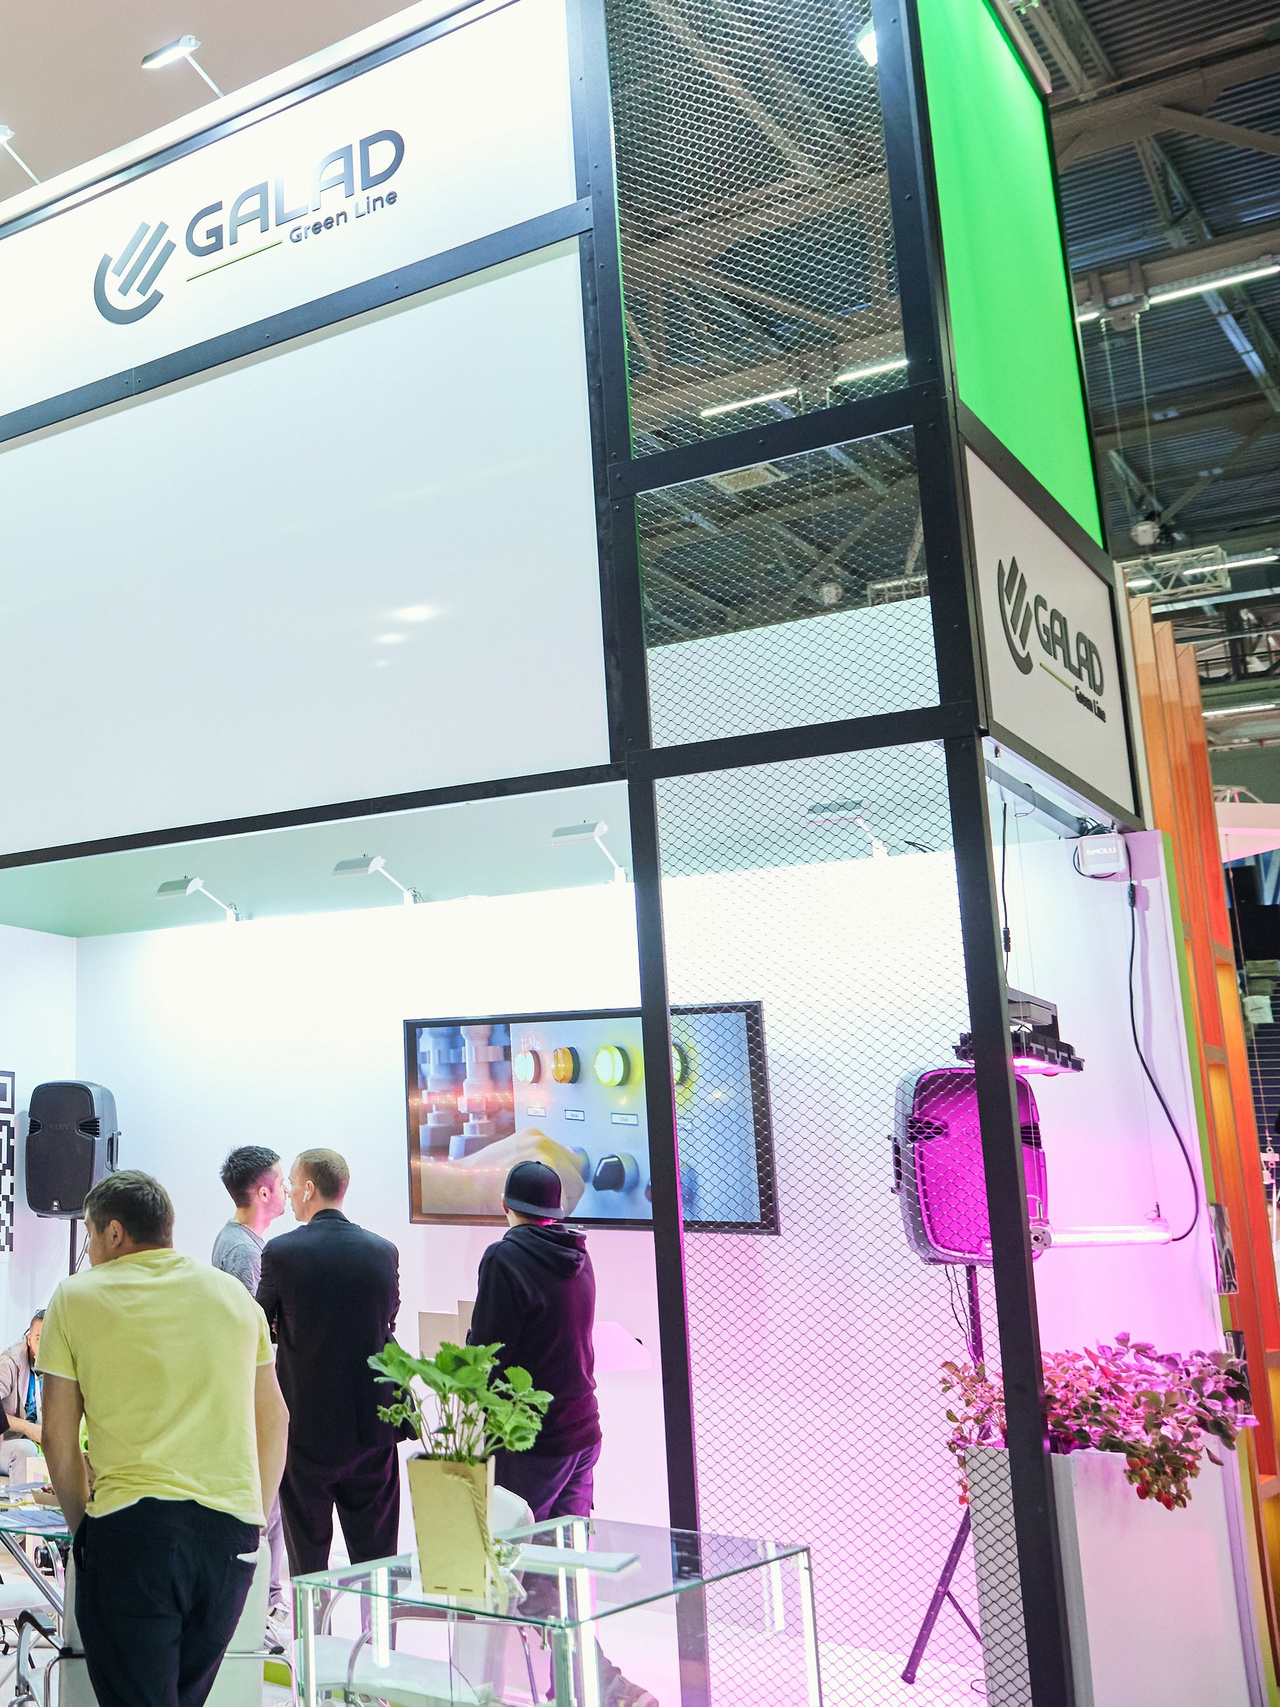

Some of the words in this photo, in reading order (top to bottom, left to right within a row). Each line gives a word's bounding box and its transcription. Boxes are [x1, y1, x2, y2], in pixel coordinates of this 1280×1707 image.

[185, 129, 405, 257] GALAD
[289, 210, 348, 244] Green
[354, 190, 398, 219] Line
[1034, 594, 1105, 697] GALAD
